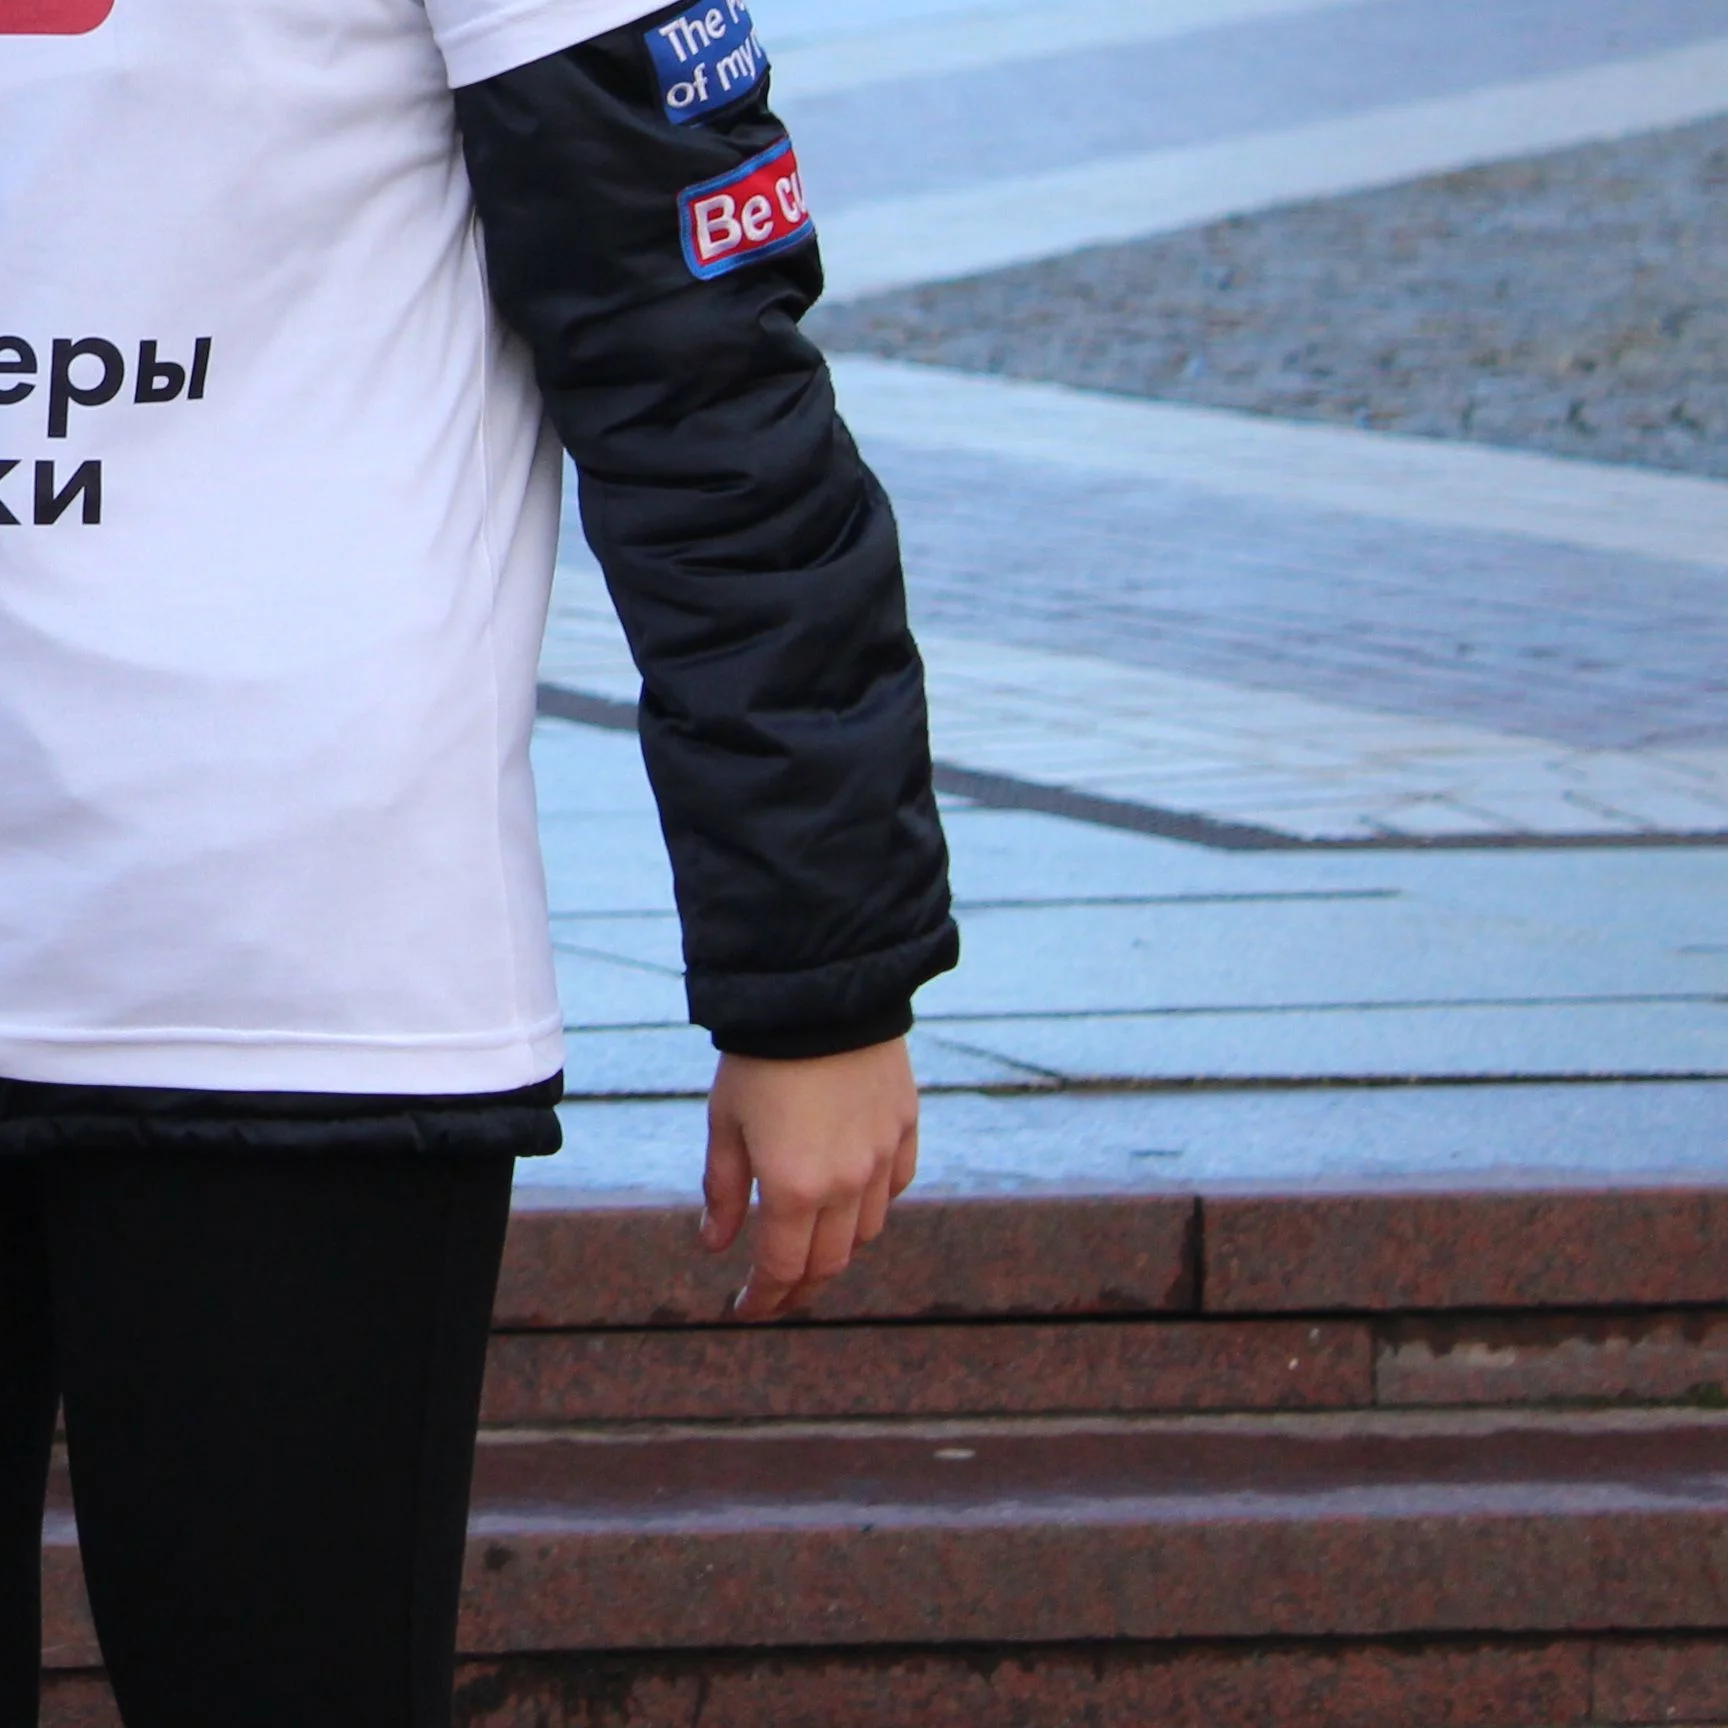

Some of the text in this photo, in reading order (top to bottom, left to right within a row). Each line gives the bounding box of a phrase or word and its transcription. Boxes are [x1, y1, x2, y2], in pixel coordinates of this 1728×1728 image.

[658, 7, 726, 63] The
[666, 62, 709, 108] of
[715, 35, 756, 92] my
[694, 193, 774, 260] Be
